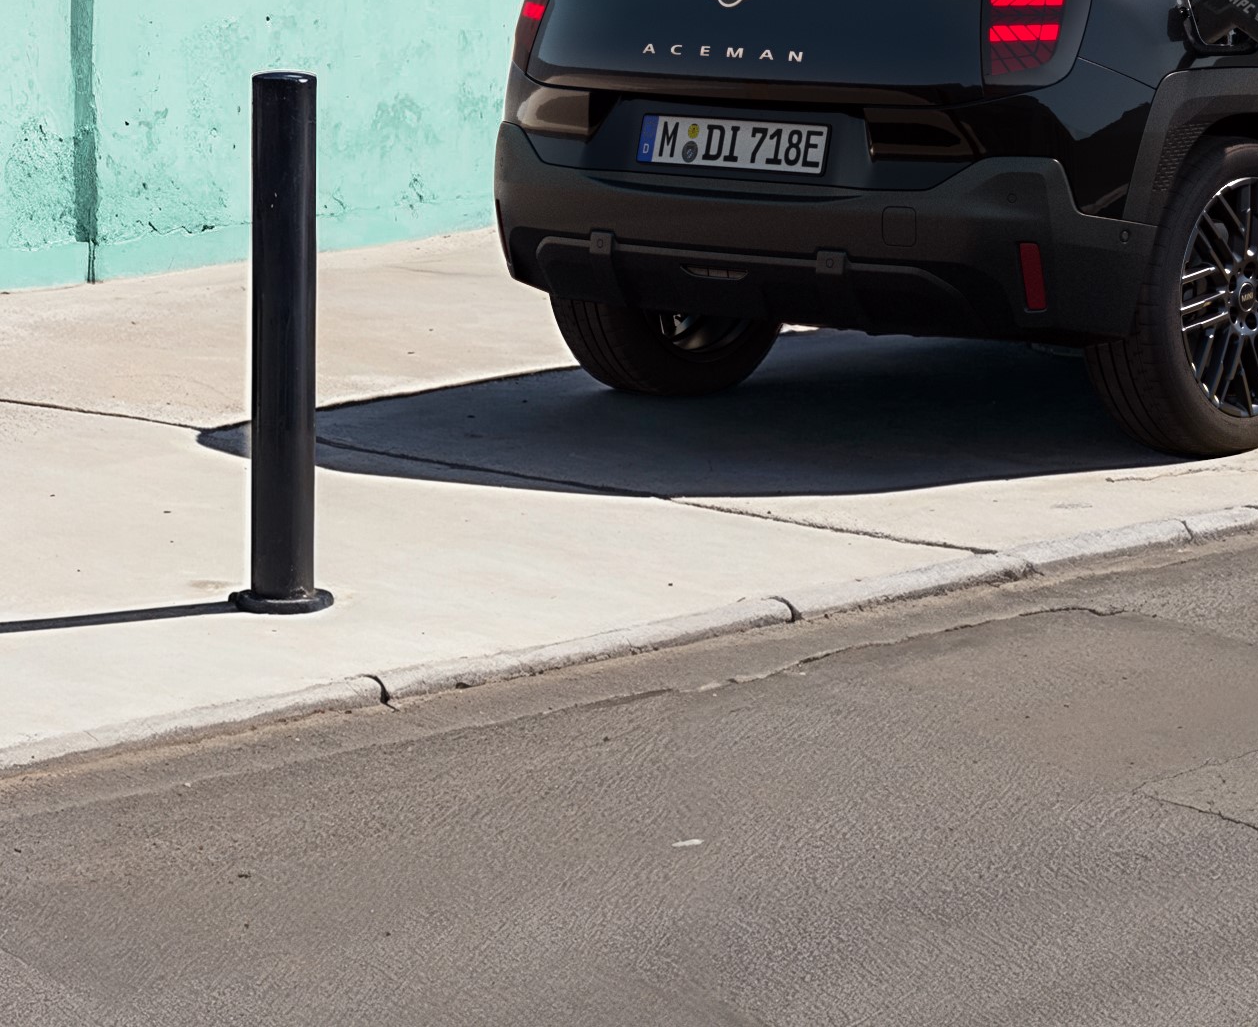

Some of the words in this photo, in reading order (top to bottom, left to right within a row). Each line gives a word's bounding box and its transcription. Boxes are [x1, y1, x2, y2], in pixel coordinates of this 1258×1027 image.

[643, 44, 803, 63] ACEMAN
[658, 121, 680, 158] M
[701, 124, 741, 163] DI
[749, 126, 824, 168] 718E
